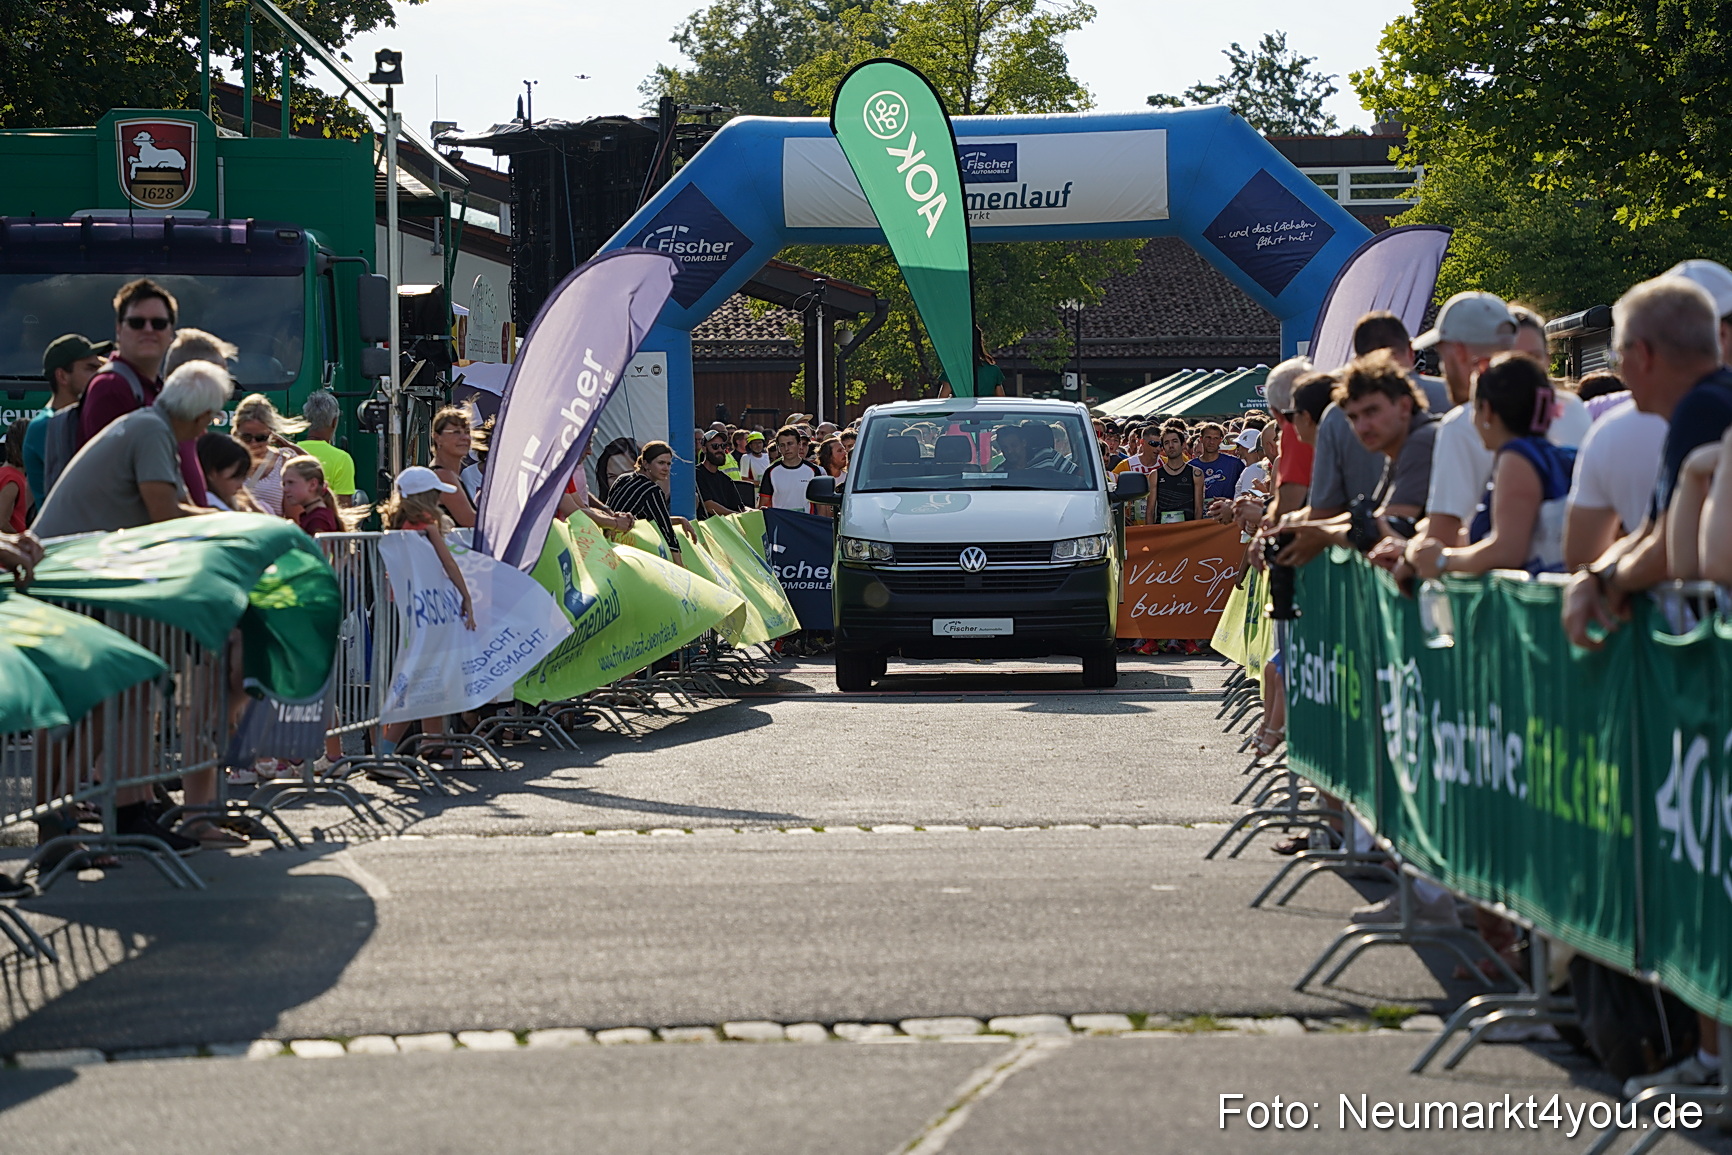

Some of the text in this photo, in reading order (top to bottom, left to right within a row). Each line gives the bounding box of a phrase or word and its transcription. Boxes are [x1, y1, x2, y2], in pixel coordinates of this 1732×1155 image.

[966, 159, 1013, 170] Fischer
[886, 131, 947, 238] AOK
[141, 187, 174, 199] 1628
[964, 181, 1072, 210] menlauf
[1252, 222, 1272, 234] das
[1288, 230, 1314, 242] mit!
[658, 238, 734, 254] Fischer
[679, 254, 728, 263] TOMOBILE
[772, 560, 834, 580] sche
[1128, 557, 1189, 585] Viel
[1193, 557, 1240, 598] Sp
[779, 581, 833, 590] OMOBILE
[1130, 593, 1199, 619] beim
[489, 623, 549, 678] GEMACHT.
